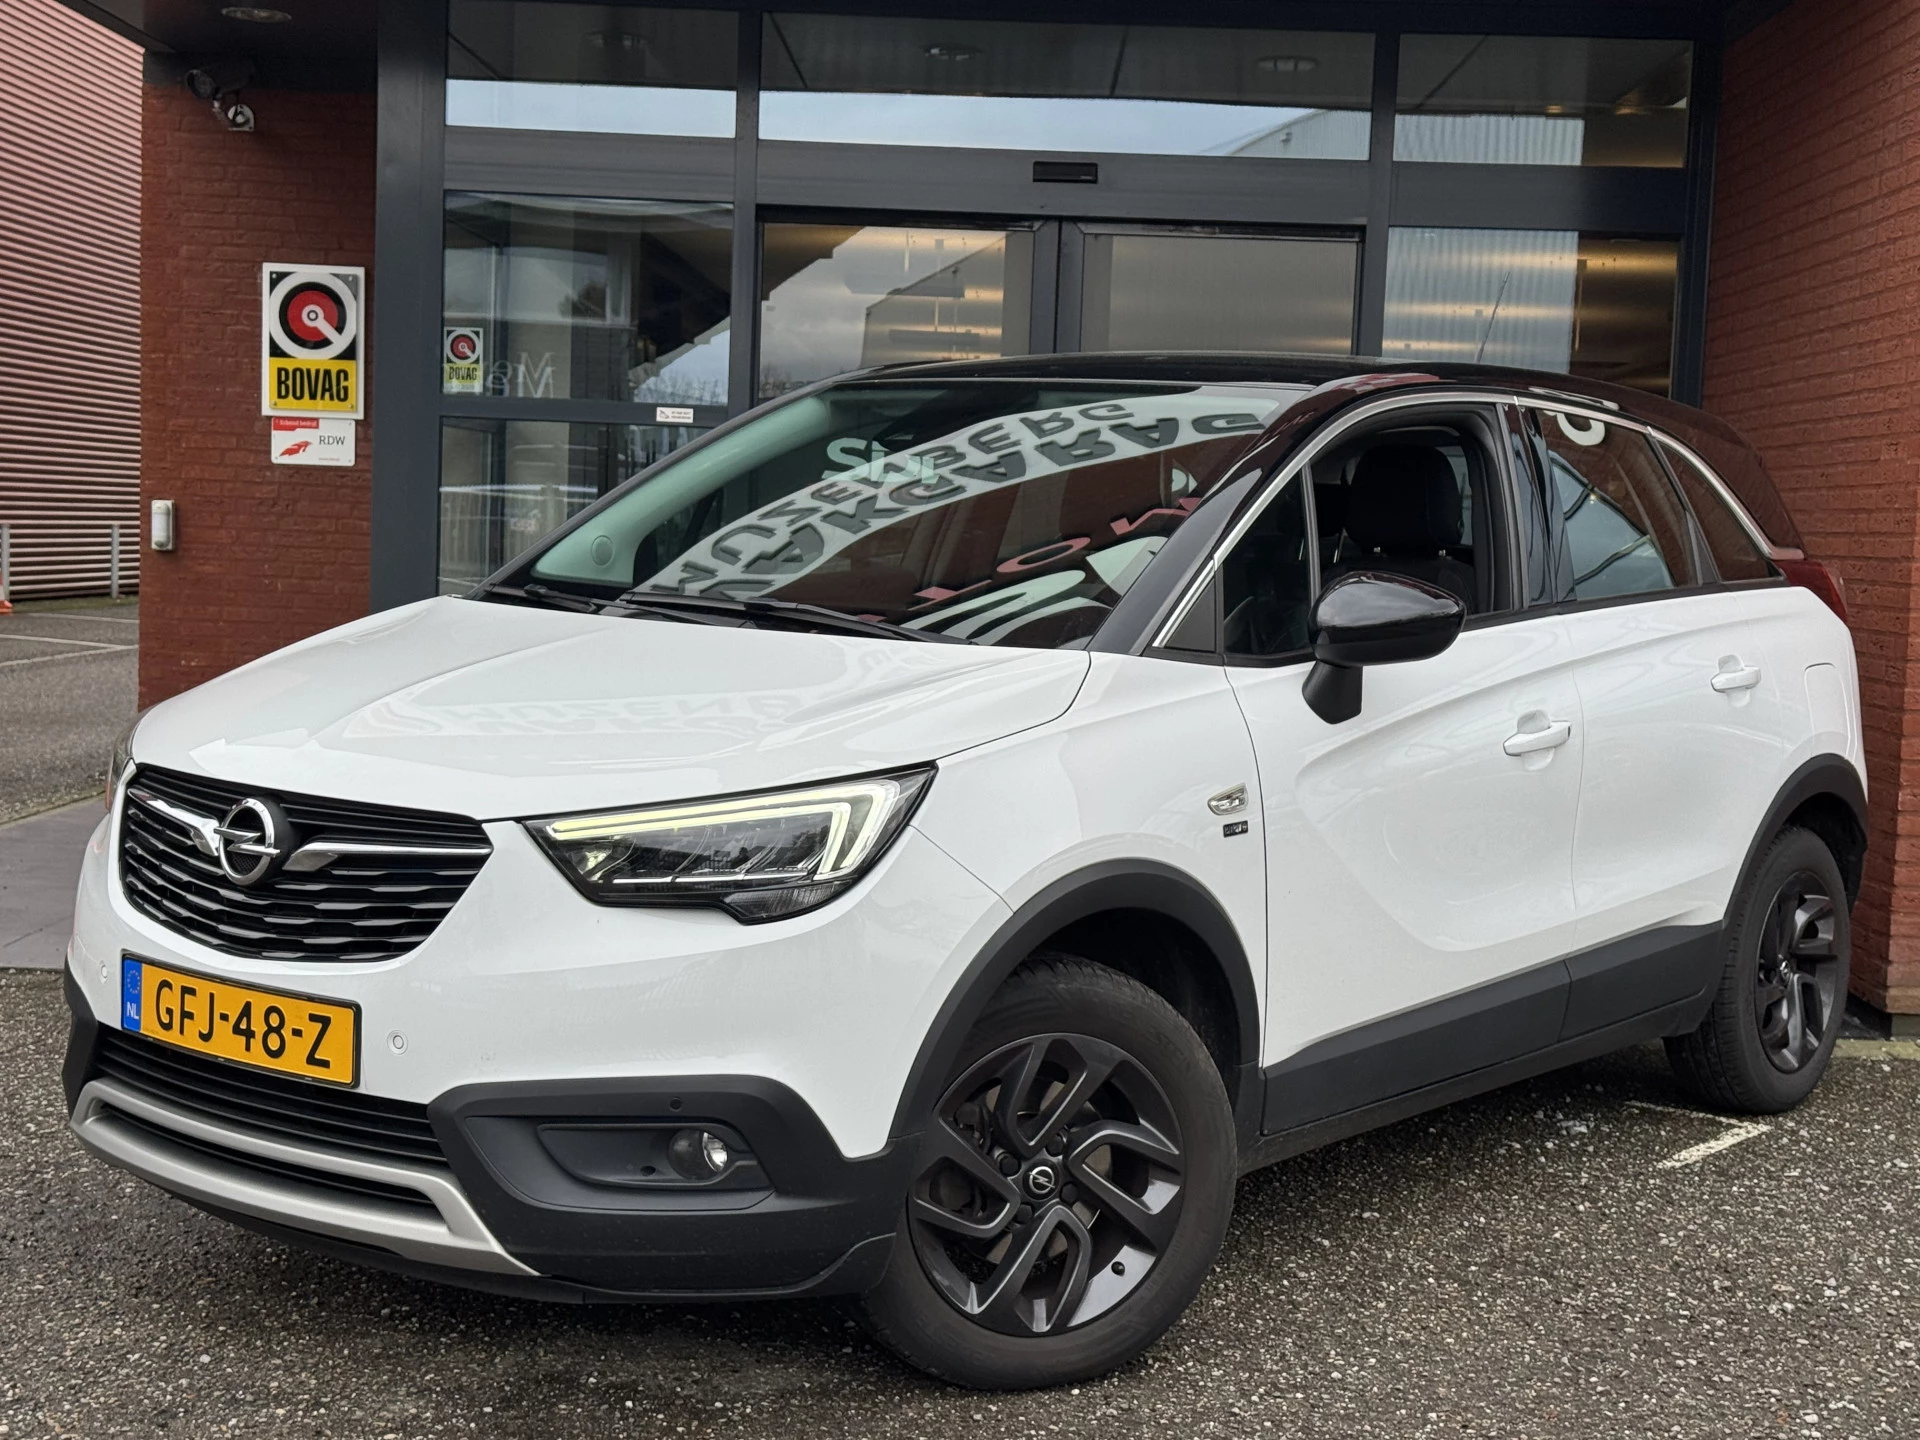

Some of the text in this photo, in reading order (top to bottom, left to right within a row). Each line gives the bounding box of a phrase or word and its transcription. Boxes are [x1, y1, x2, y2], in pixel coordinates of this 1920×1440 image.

[448, 366, 478, 381] BOVAG
[276, 366, 349, 403] BOVAG
[319, 435, 346, 446] RDW
[126, 1001, 140, 1020] NL
[155, 979, 332, 1069] GFJ-48-Z
